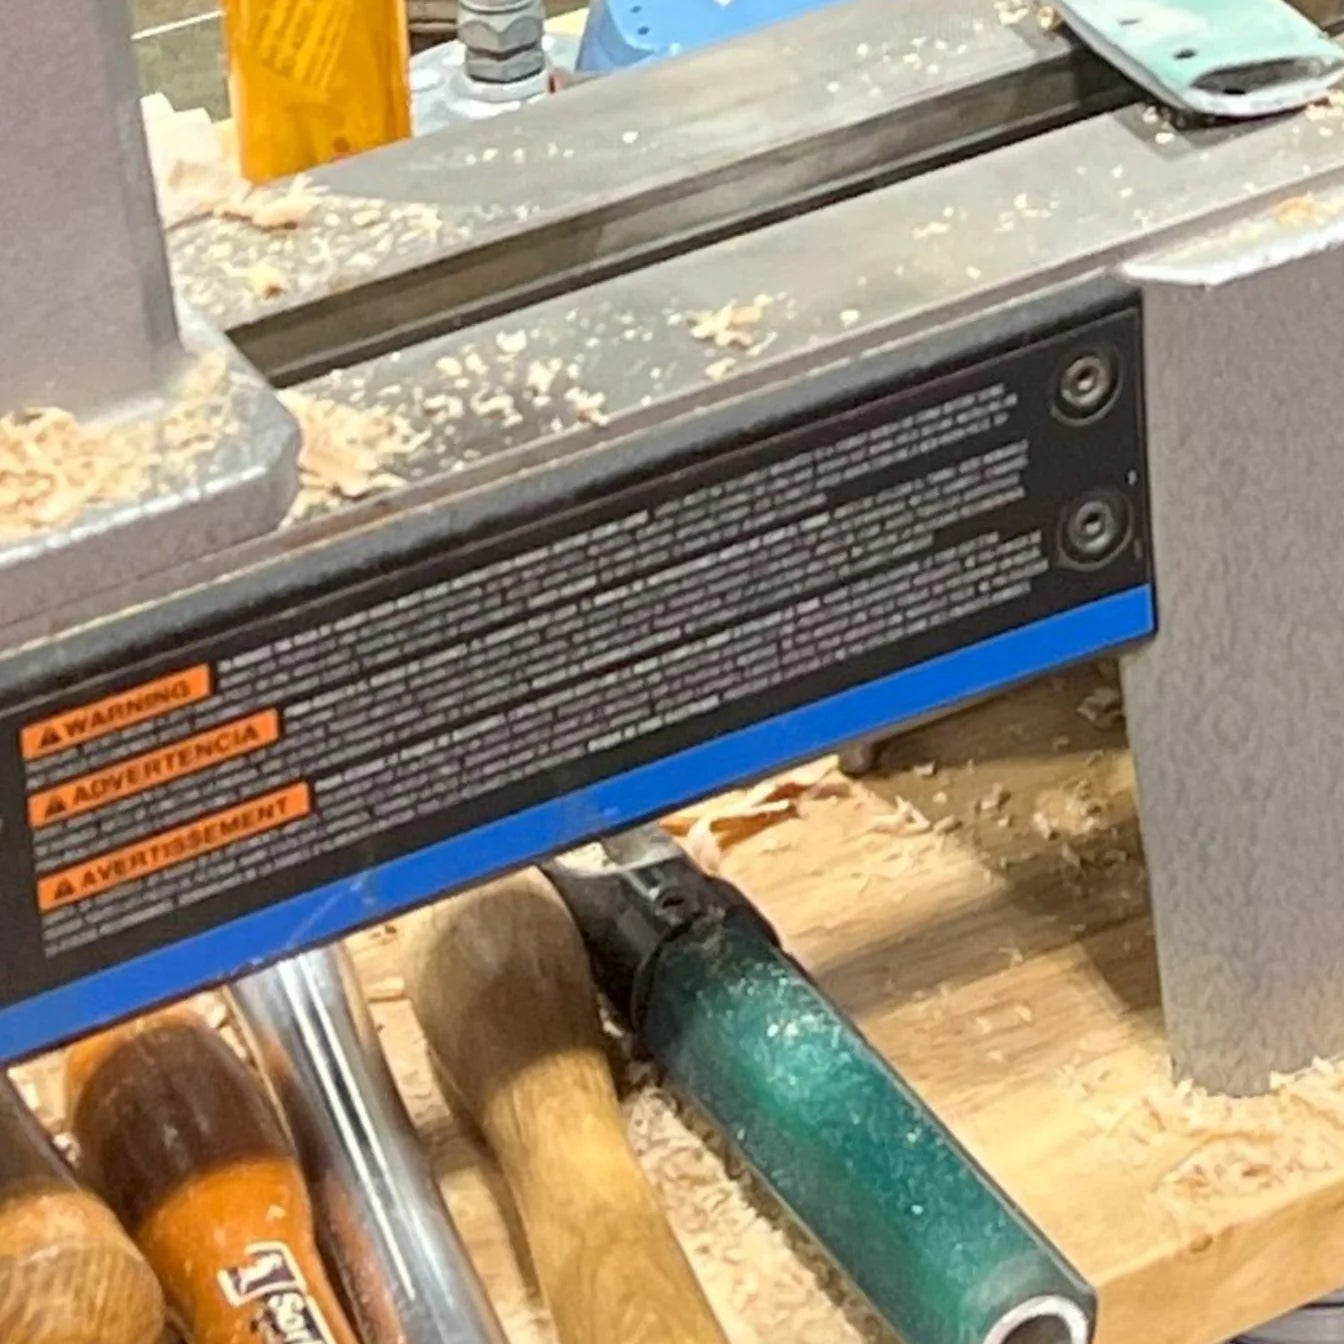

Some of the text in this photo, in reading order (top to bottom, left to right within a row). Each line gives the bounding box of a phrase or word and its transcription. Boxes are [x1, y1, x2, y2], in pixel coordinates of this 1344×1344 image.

[62, 679, 192, 737] WARNING
[72, 723, 259, 805] ADVERTENCIA
[80, 795, 289, 890] AVERTISSEMENT
